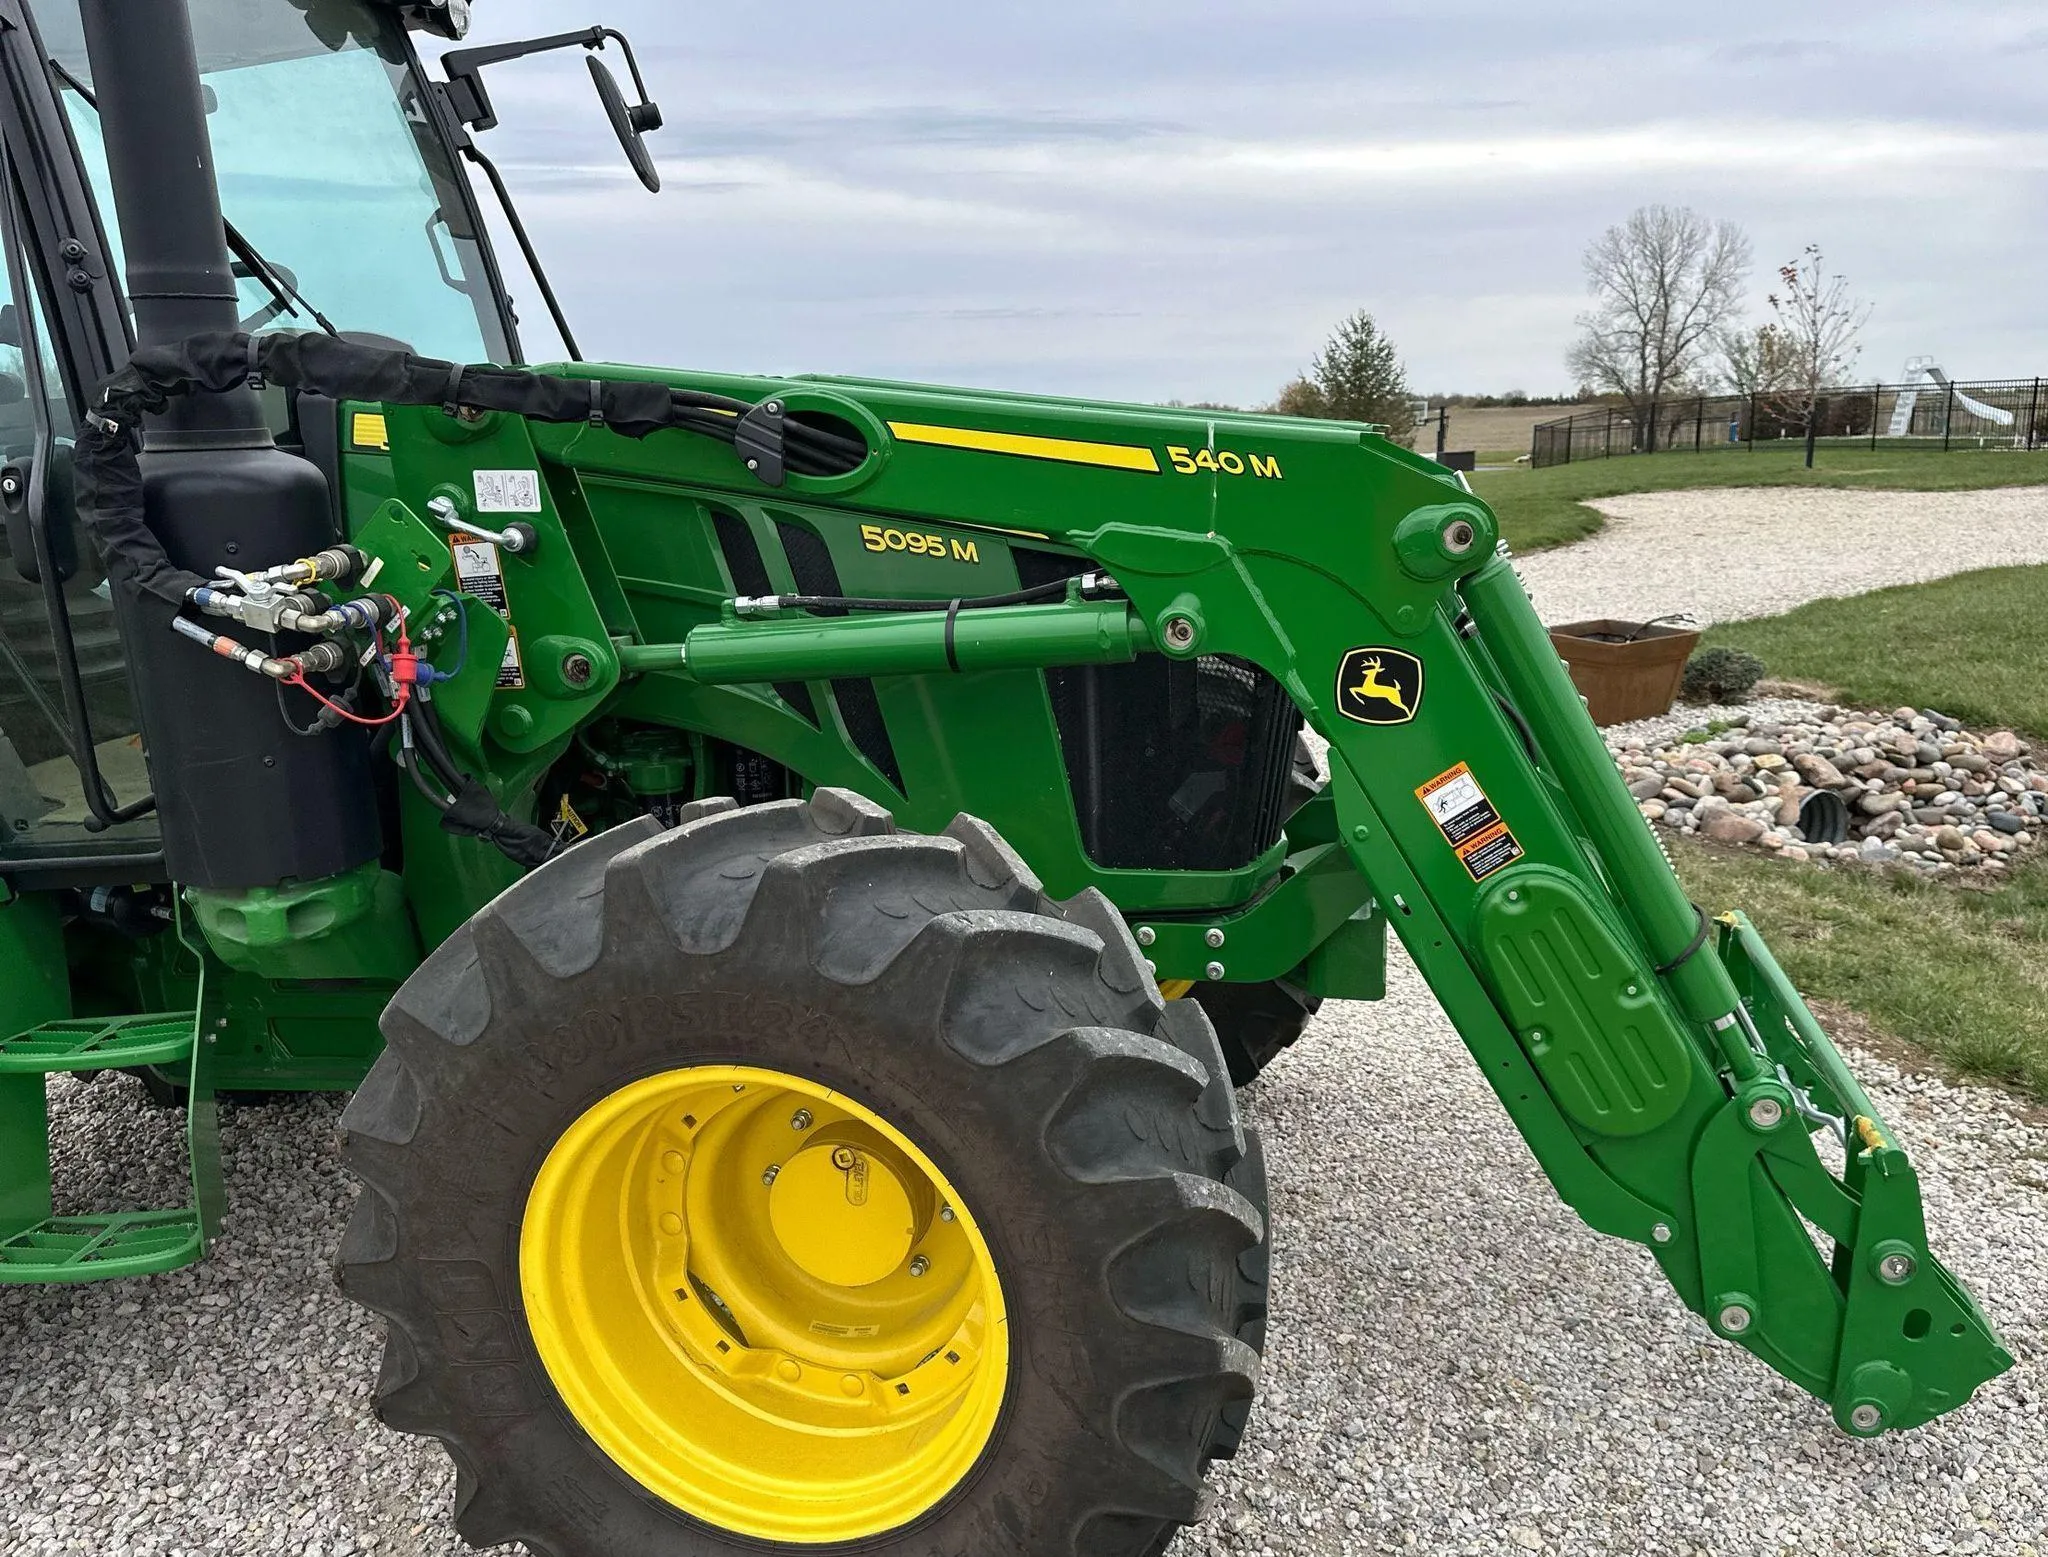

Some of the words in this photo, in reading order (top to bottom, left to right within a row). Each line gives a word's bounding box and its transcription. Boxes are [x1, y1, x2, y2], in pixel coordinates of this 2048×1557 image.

[1165, 444, 1246, 476] 540
[1248, 453, 1285, 480] M
[859, 523, 947, 558] 5095
[949, 537, 980, 564] M
[1430, 767, 1462, 790] WARNING
[1470, 827, 1503, 850] WARNING
